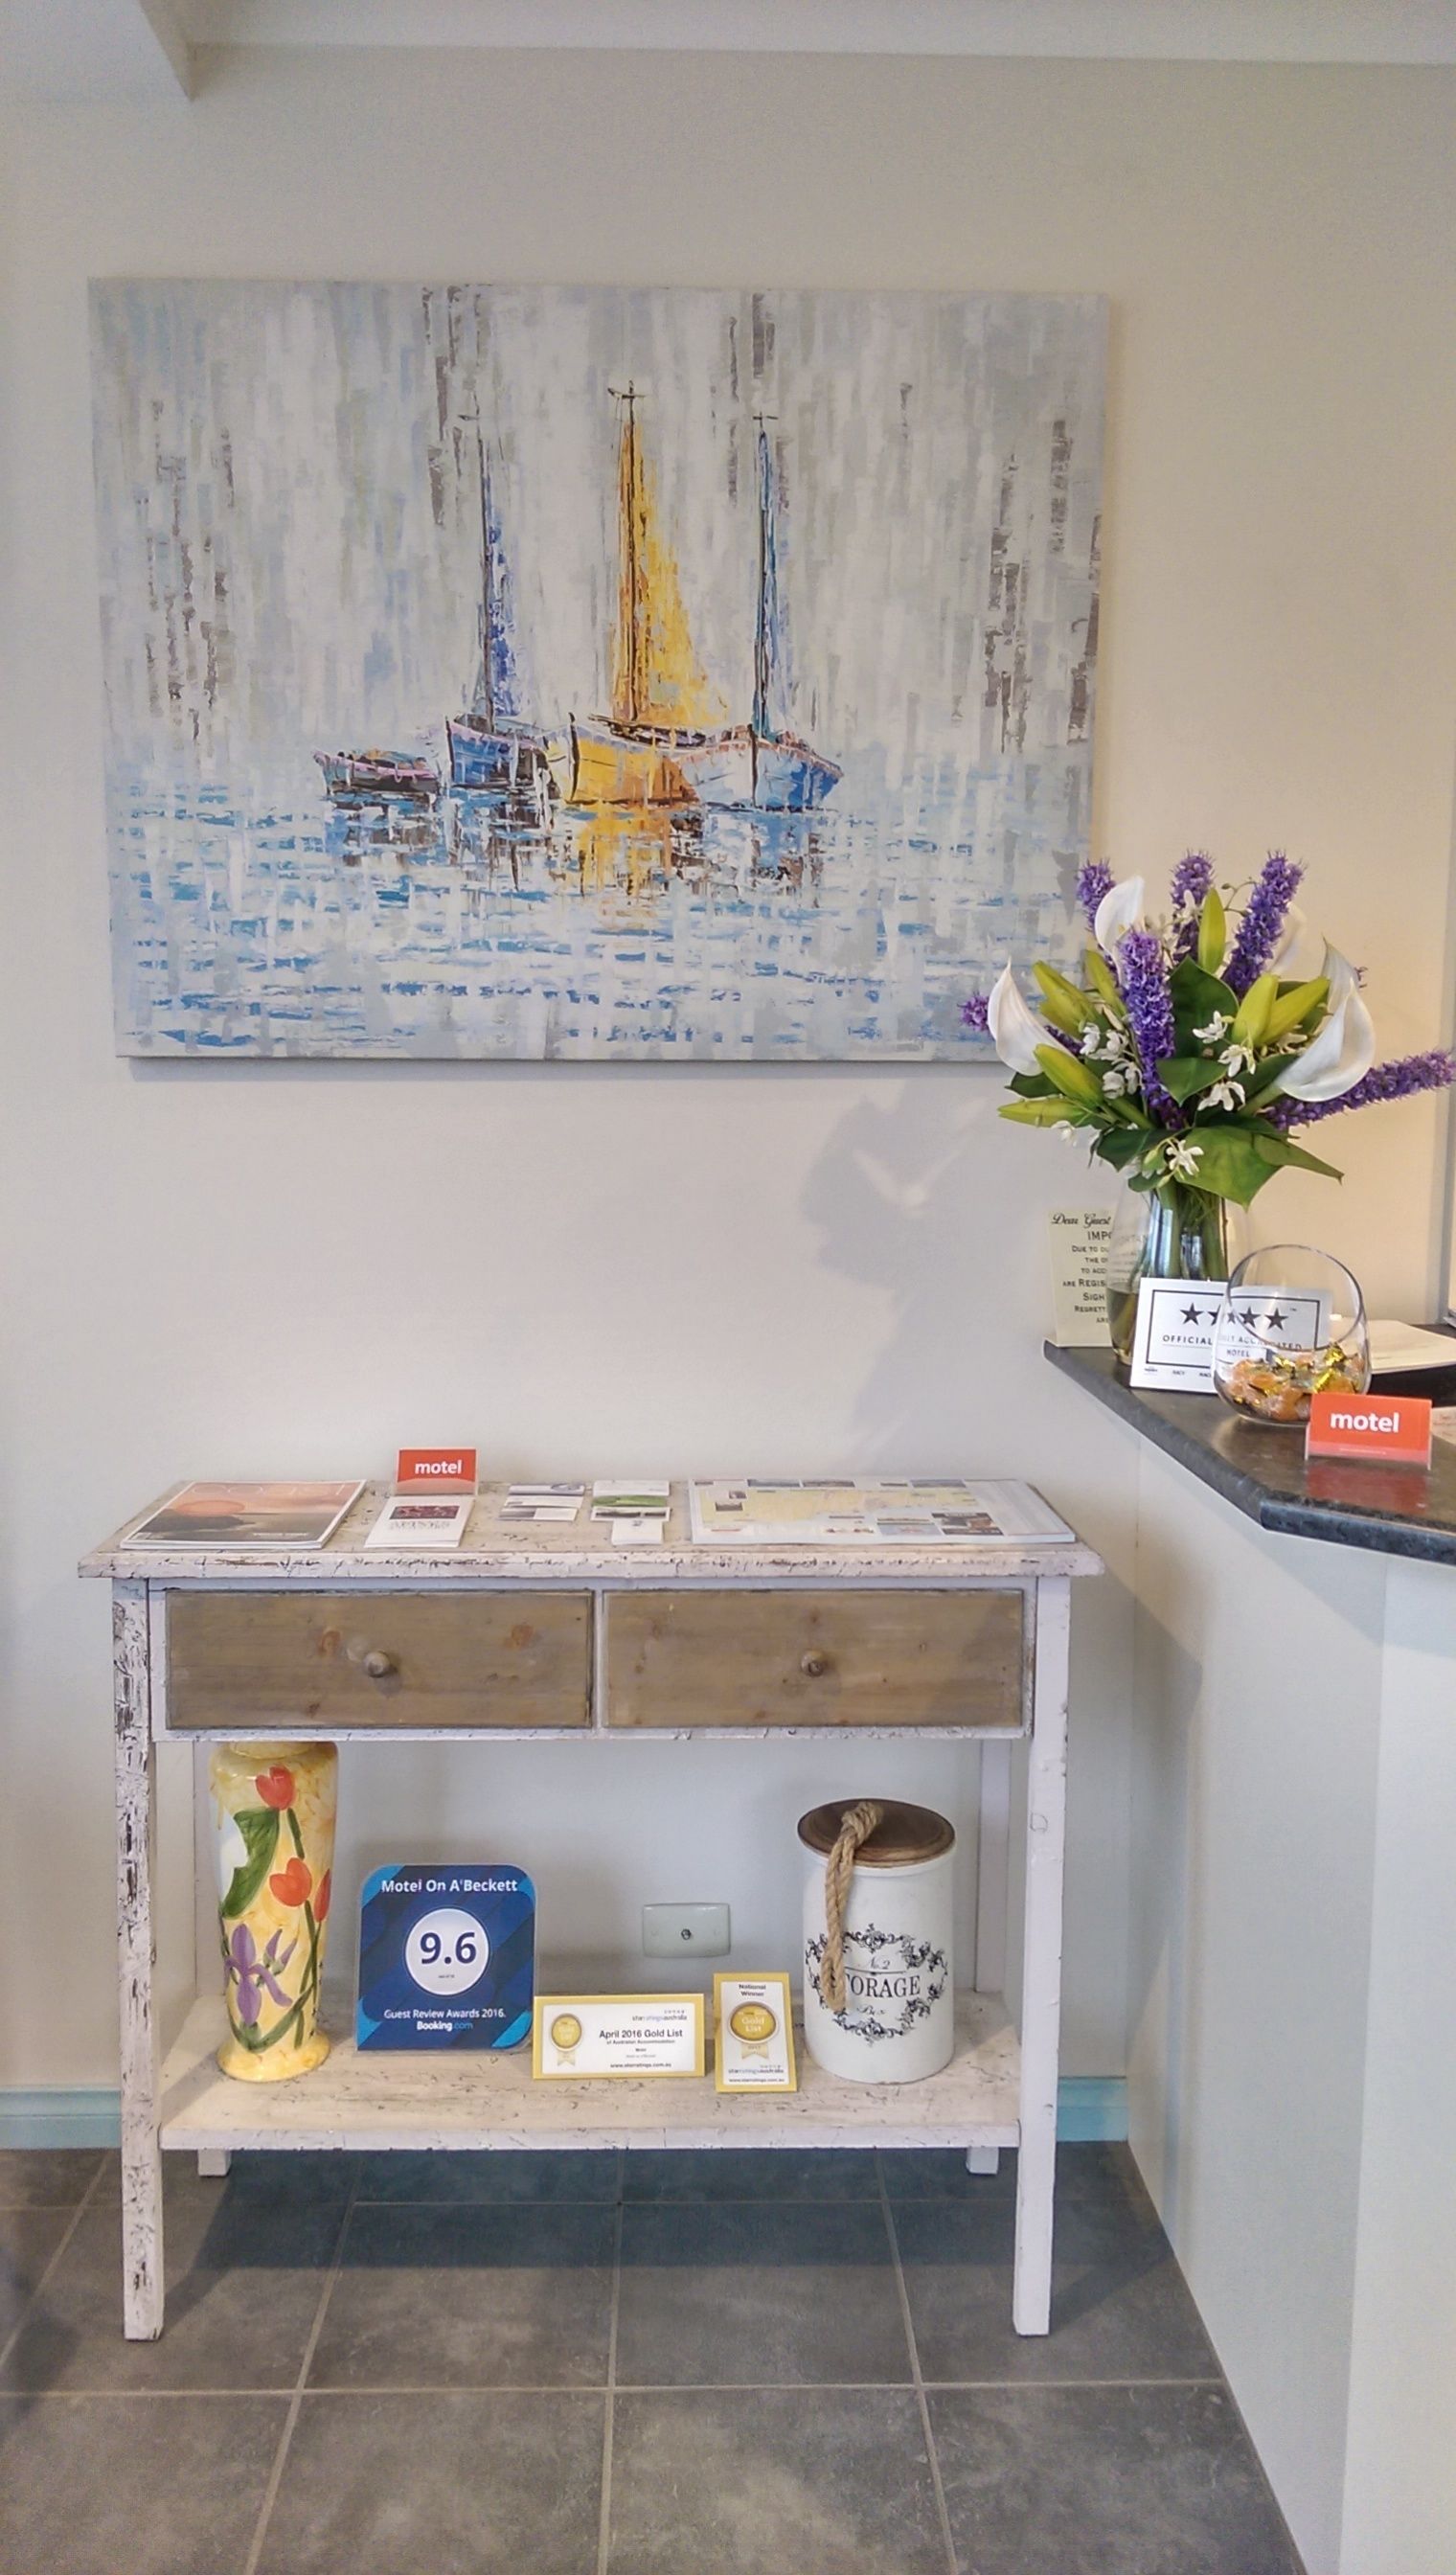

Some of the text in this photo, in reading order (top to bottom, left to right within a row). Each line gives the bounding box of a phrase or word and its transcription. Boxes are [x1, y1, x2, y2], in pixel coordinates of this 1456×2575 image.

[1051, 1213, 1079, 1225] Dear
[1079, 1279, 1106, 1288] REGIS
[1162, 1333, 1213, 1347] OFFICIAL
[1330, 1412, 1399, 1433] motel
[415, 1459, 463, 1474] motel
[381, 1879, 518, 1892] Motel On A'Beckett
[420, 1931, 477, 1965] 9.6
[846, 1973, 921, 1998] ORAGE
[384, 2008, 507, 2018] Guest Review Awards 2016.
[417, 2020, 474, 2032] Booking.com
[741, 2017, 765, 2025] Gold
[599, 2030, 620, 2039] April
[622, 2030, 642, 2039] 2016
[644, 2030, 665, 2039] Gold
